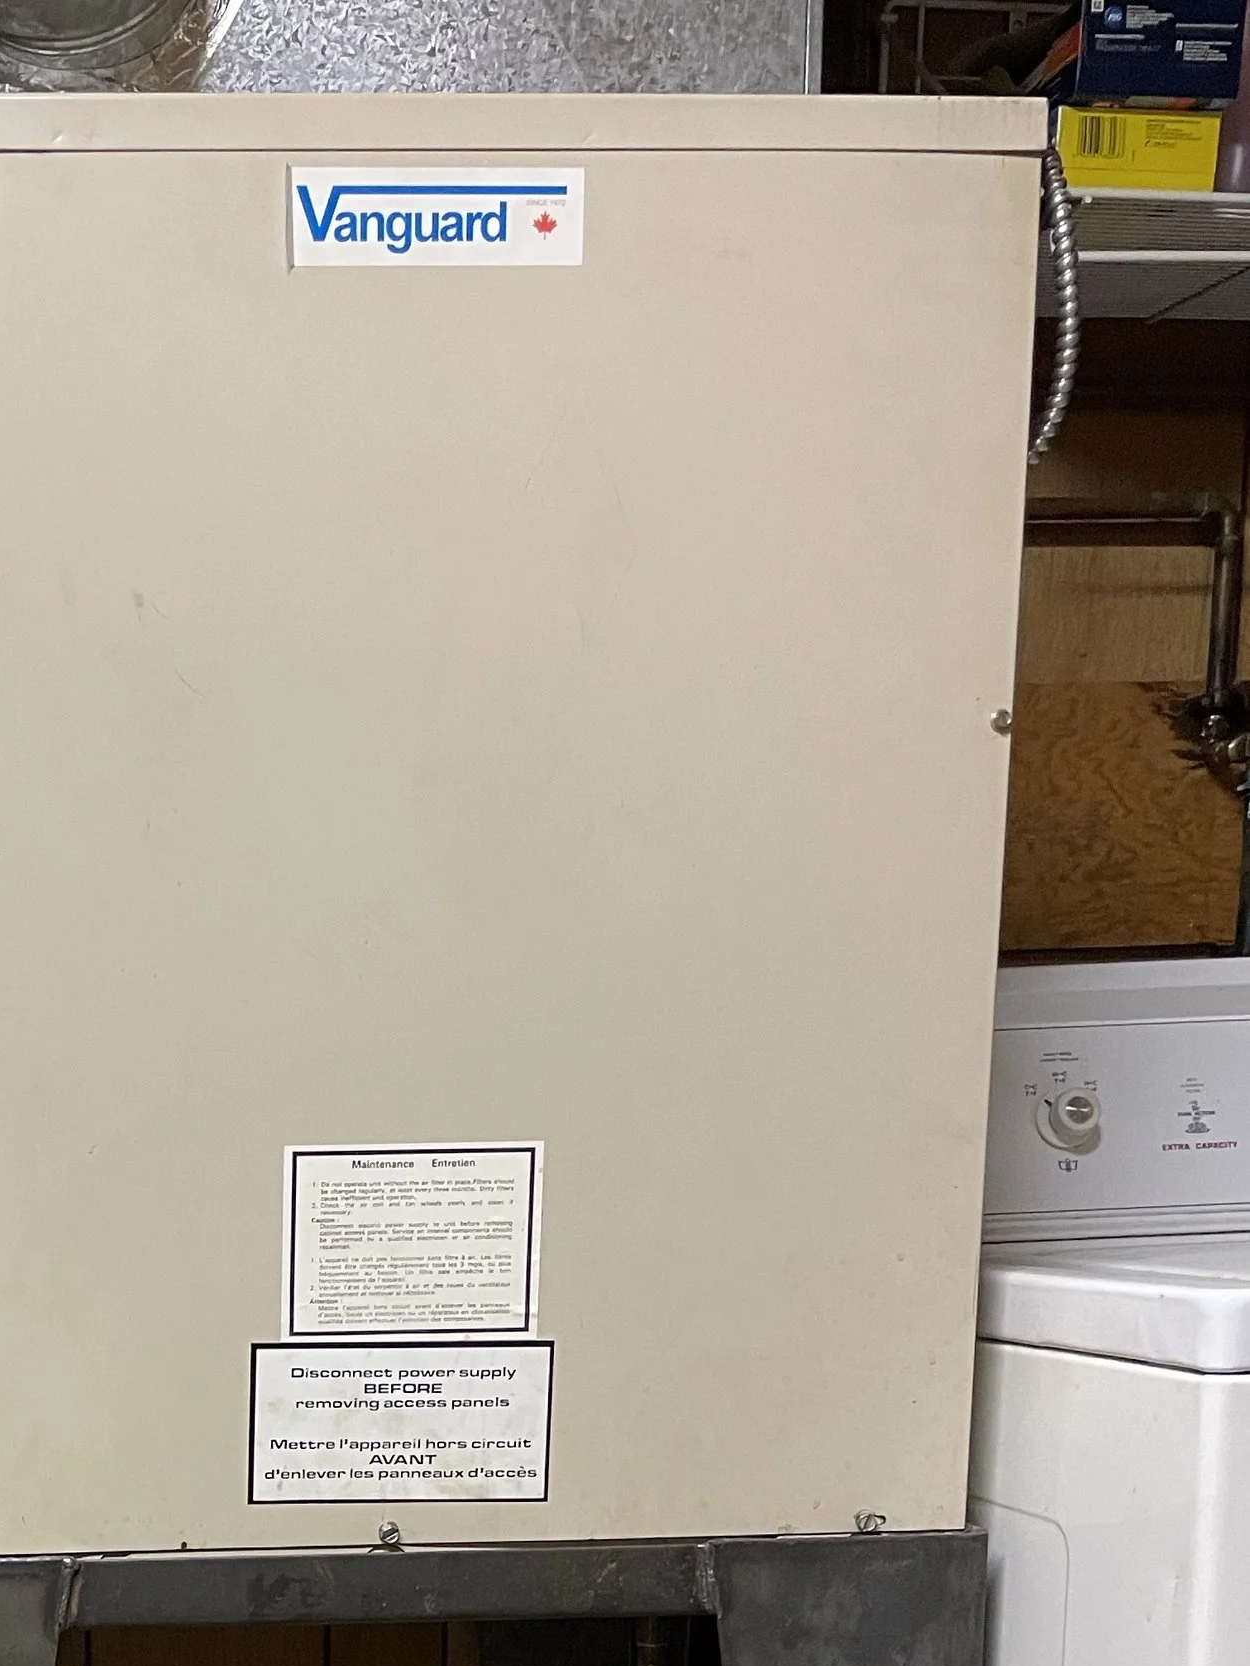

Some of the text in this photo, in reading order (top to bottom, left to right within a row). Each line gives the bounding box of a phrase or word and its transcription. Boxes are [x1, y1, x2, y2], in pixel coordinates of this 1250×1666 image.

[296, 185, 507, 254] Vanguard
[1161, 1141, 1238, 1152] EXTRA CAPACITY
[351, 1158, 476, 1169] Maintenance Entretien
[290, 1366, 517, 1381] Disconnect power supply
[363, 1383, 443, 1394] BEFORE
[295, 1396, 510, 1411] removing access panels
[270, 1437, 532, 1452] Mettre l'appareil hors circuit
[368, 1454, 437, 1465] AVANT
[264, 1465, 538, 1480] d'enlever les panneaux d'accès
